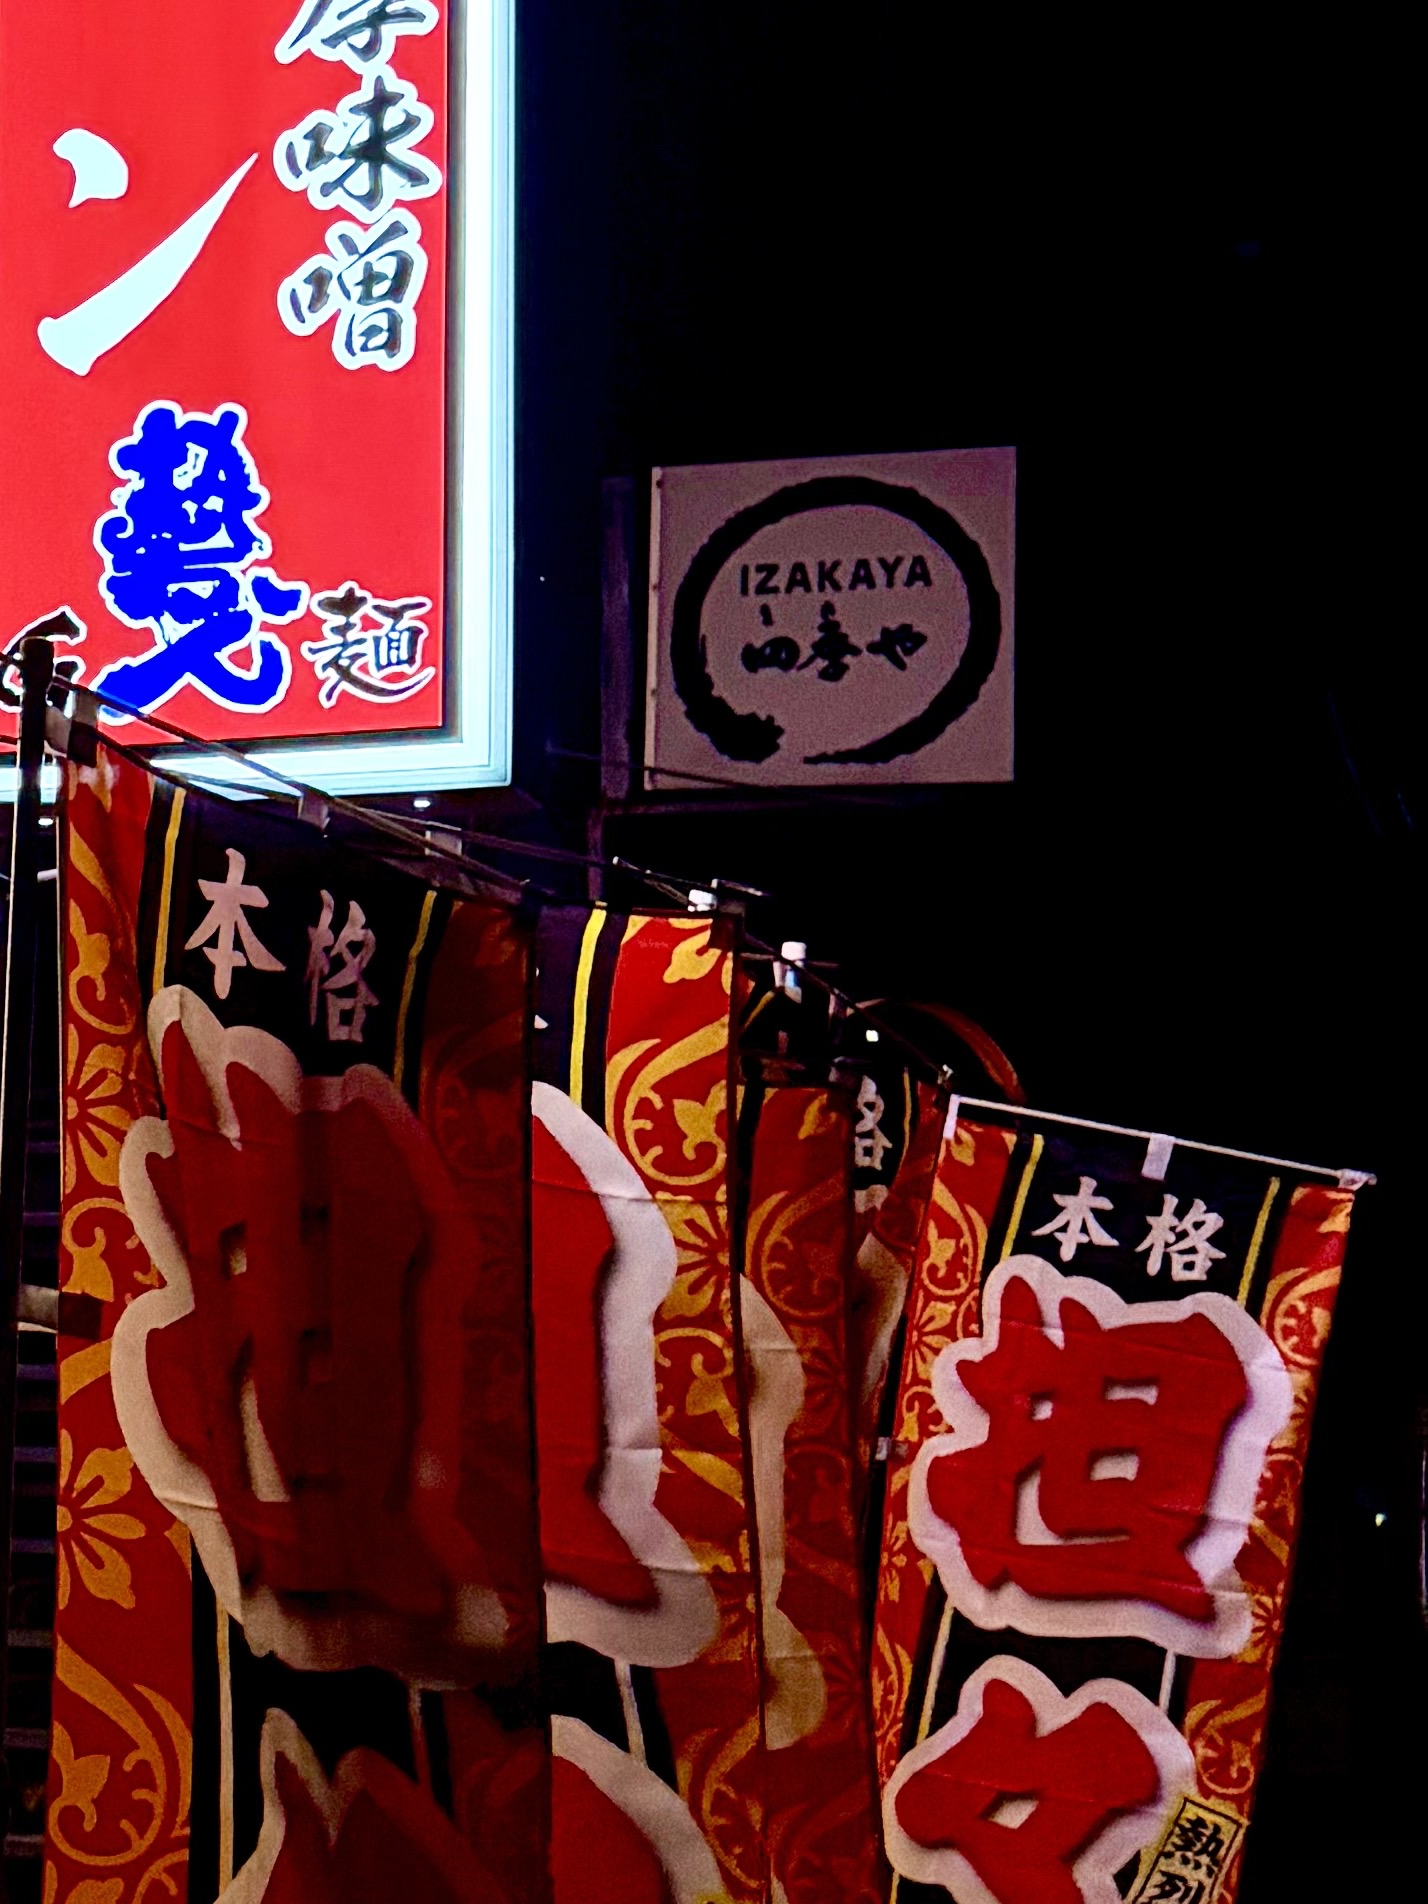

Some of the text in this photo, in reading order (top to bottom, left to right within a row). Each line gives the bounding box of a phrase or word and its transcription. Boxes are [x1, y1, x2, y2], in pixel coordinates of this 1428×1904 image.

[741, 555, 932, 597] IZAKAYA
[741, 621, 927, 681] 四季や
[184, 847, 381, 1045] 本格
[1031, 1176, 1227, 1282] 本格
